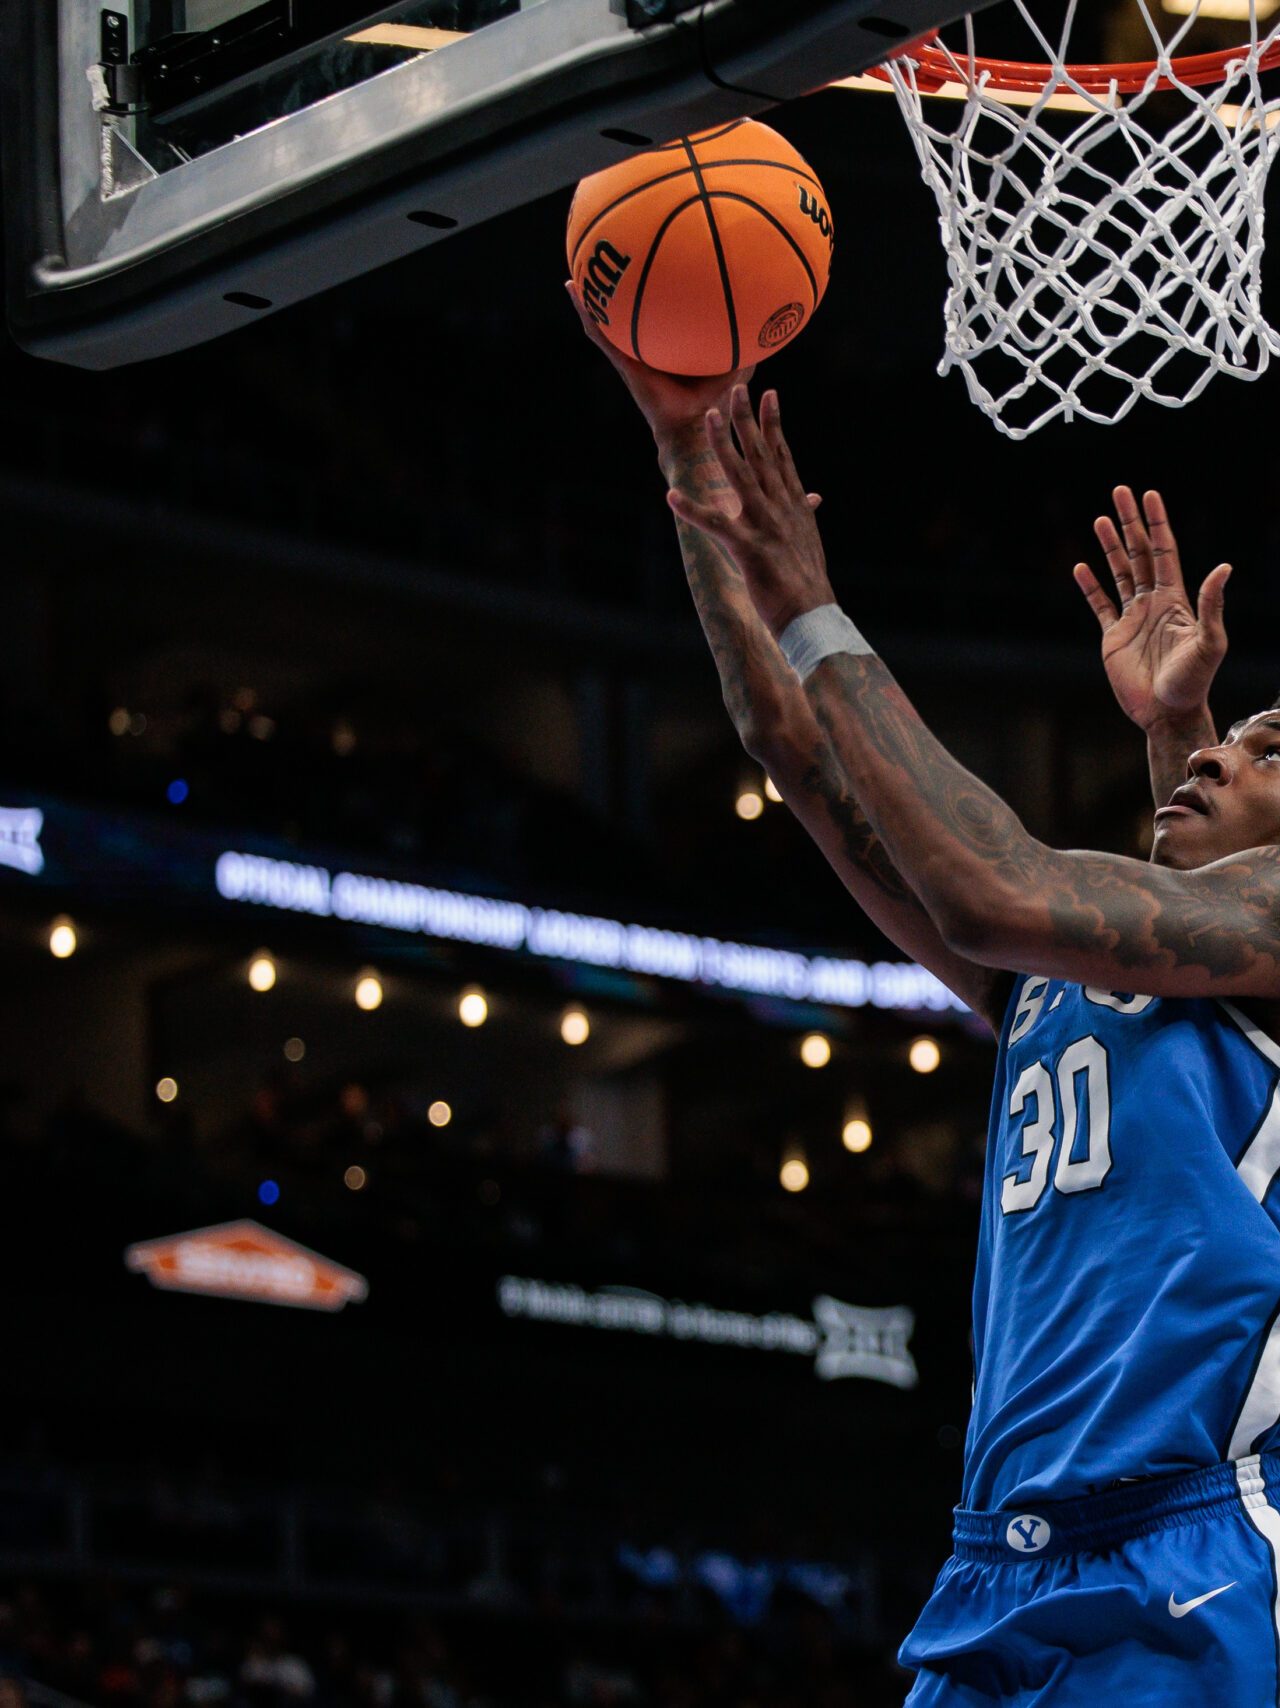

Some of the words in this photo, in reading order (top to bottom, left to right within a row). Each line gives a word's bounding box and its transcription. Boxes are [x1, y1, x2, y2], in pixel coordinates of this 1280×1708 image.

[583, 239, 632, 326] Wil
[1000, 1033, 1113, 1216] 30
[1011, 1518, 1042, 1549] Y
